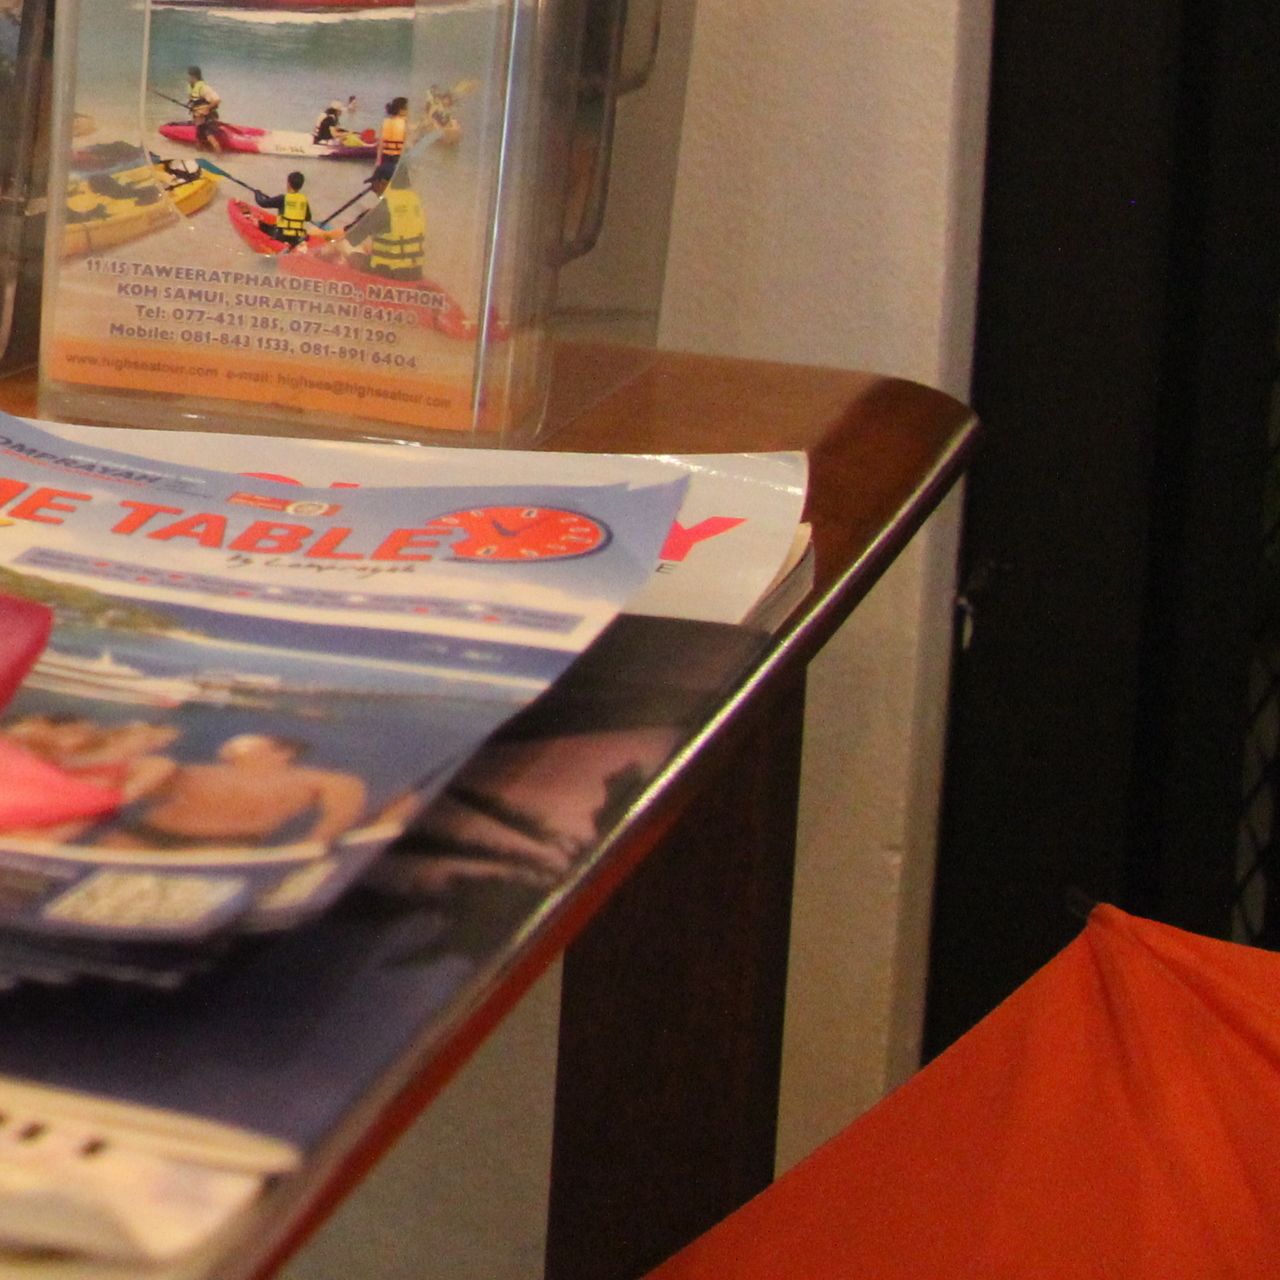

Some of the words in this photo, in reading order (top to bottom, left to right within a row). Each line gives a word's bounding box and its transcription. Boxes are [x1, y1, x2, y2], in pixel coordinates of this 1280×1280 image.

[132, 263, 322, 293] TAWEERATPHAKDEE
[117, 282, 158, 298] KOH
[164, 286, 229, 307] SAMUI,
[235, 293, 359, 319] SURATTHANI
[135, 304, 166, 319] Tel:
[172, 308, 244, 326] 077-421
[251, 316, 284, 332] 285,
[290, 321, 360, 341] 077-421
[366, 329, 397, 345] 290
[109, 322, 175, 341] Mobile:
[180, 329, 251, 348] 081-843
[257, 336, 295, 355] 1533,
[299, 341, 365, 361] 081-891
[371, 352, 418, 369] 6404
[110, 500, 441, 563] TABLE
